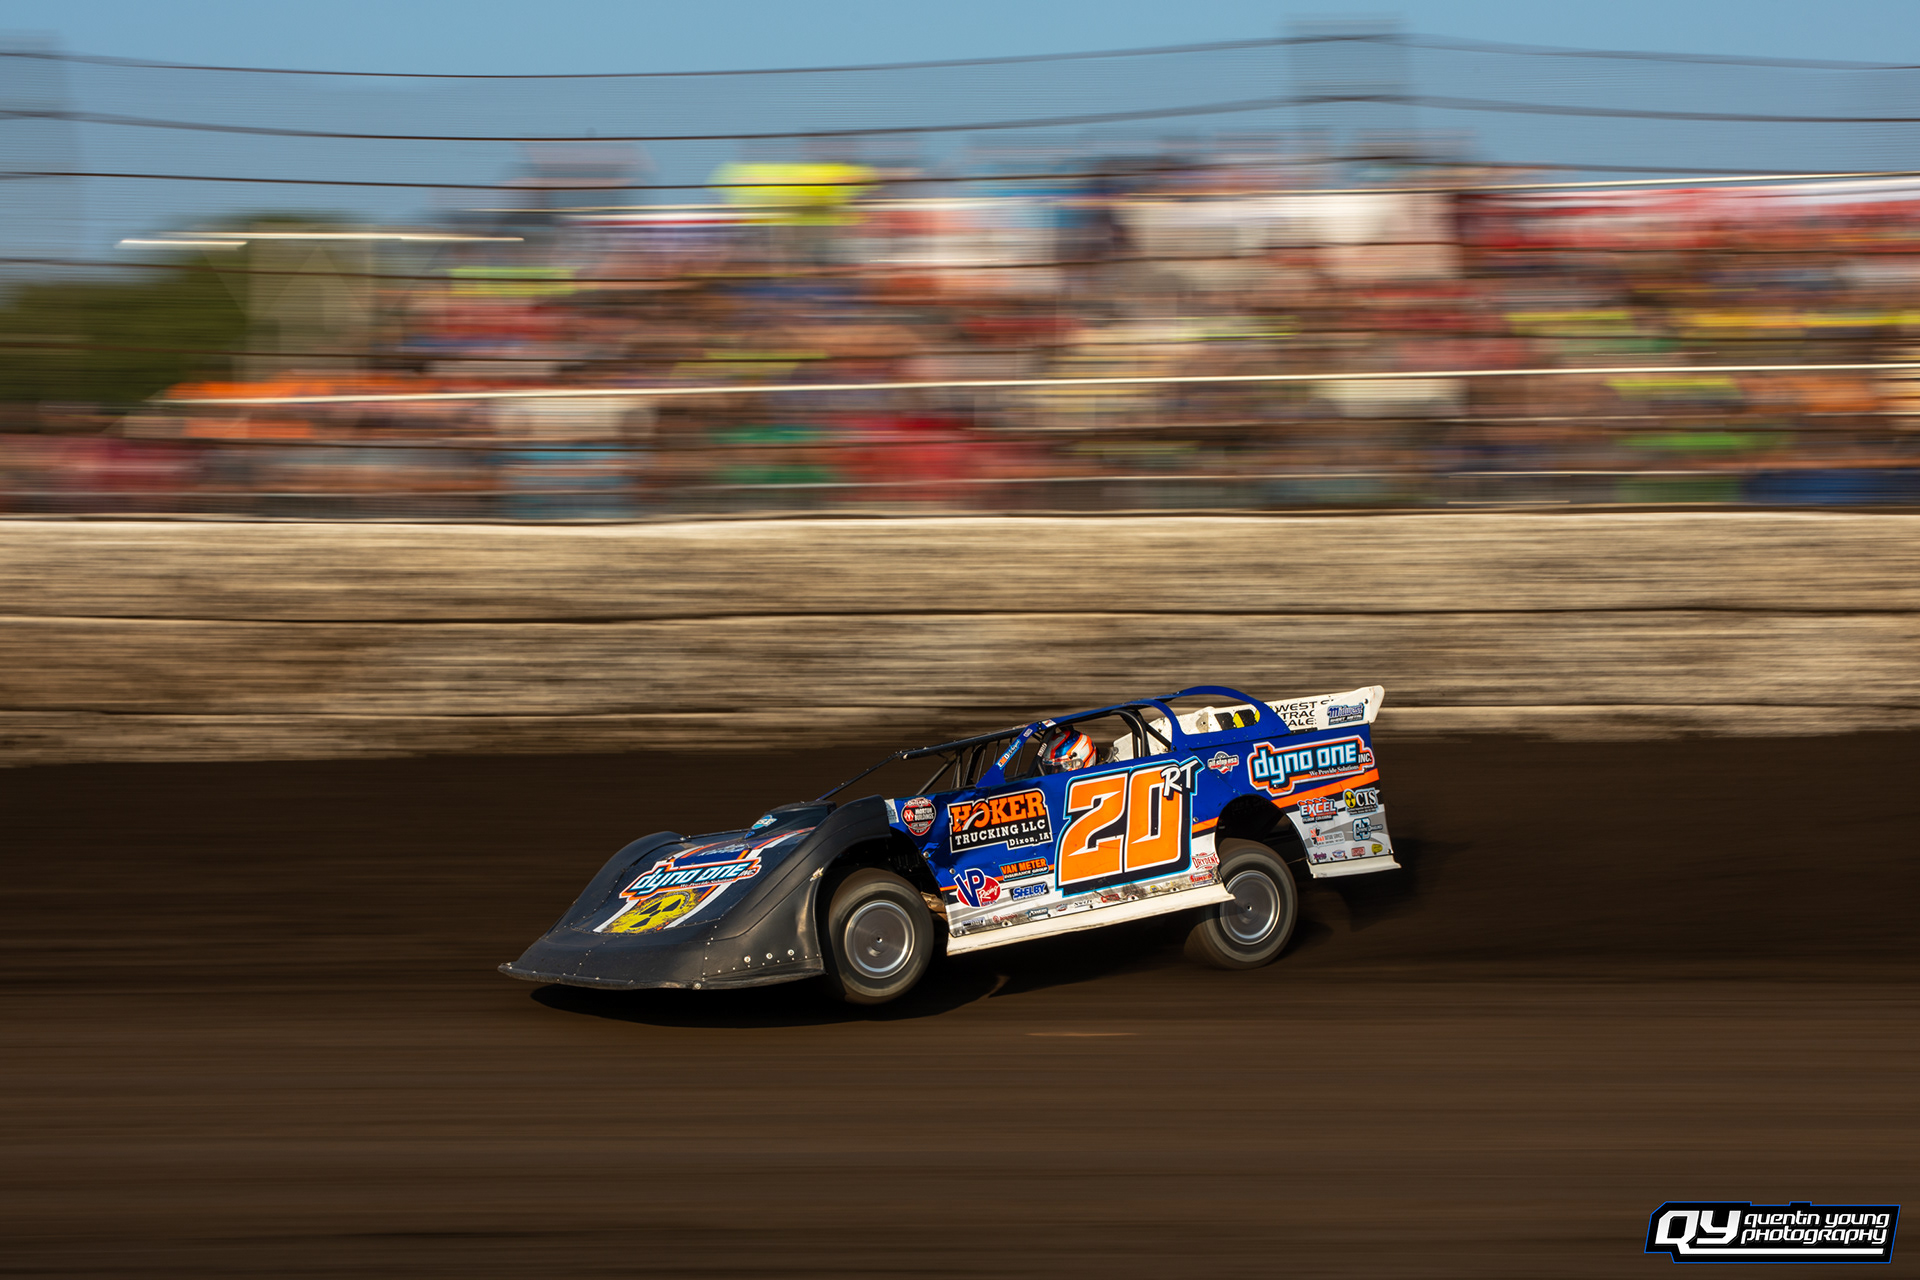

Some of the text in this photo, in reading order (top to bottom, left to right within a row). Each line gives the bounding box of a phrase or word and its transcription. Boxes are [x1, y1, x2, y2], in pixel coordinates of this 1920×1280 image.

[1328, 702, 1363, 718] Midwest
[1253, 749, 1314, 786] dyno
[1318, 767, 1337, 776] Provide
[1337, 764, 1360, 772] Solutions
[1160, 759, 1199, 797] RT
[1356, 789, 1377, 808] CIS
[1301, 801, 1337, 816] EXCEL
[955, 819, 1046, 846] TRUCKING LLC
[1059, 767, 1182, 886] 20
[1009, 836, 1038, 847] Dixon,
[1000, 858, 1047, 875] VAN METER
[630, 867, 704, 895] dyno
[954, 868, 985, 908] VP
[979, 883, 1000, 900] Racing
[1013, 883, 1046, 899] SHELBY
